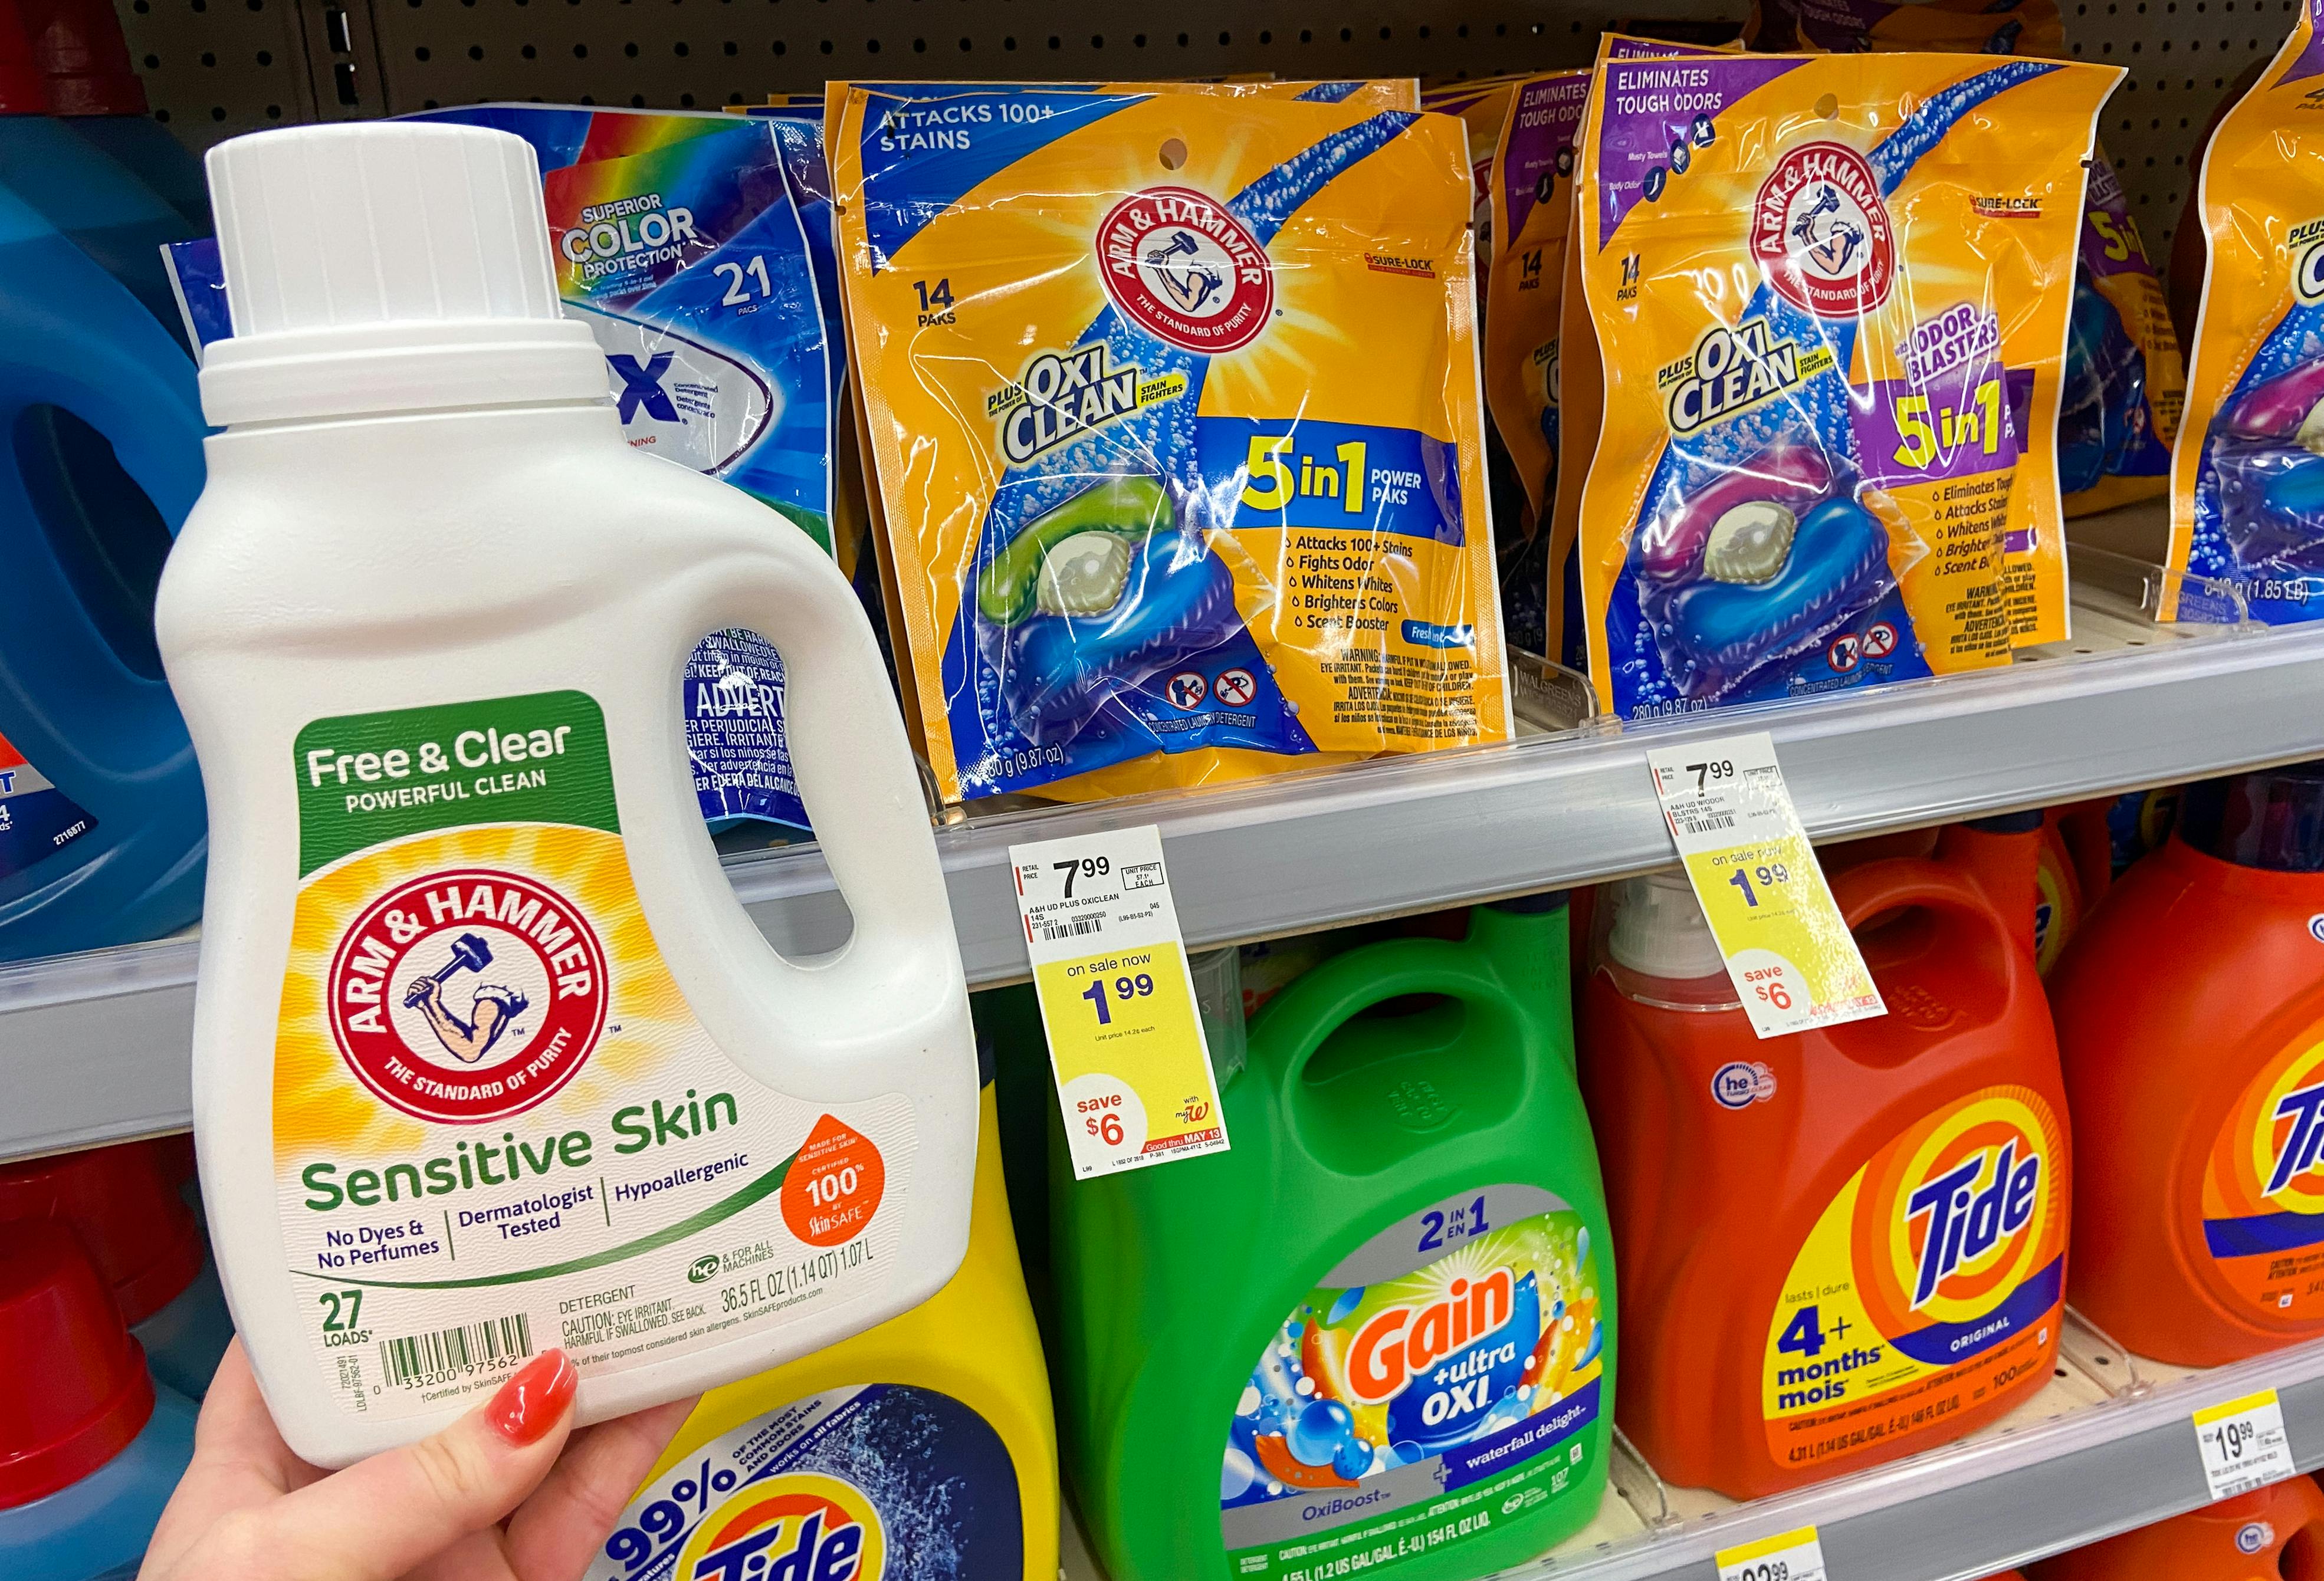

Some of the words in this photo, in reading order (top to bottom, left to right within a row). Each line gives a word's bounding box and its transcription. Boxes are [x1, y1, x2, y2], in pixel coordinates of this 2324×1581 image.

[1618, 70, 1709, 90] ELIMINATES
[881, 105, 992, 129] ATTACKS
[999, 104, 1053, 124] 100+
[1616, 97, 1669, 114] TOUGH
[1674, 93, 1722, 110] ODORS
[881, 132, 970, 152] STAINS
[583, 195, 662, 223] SUPERIOR
[1759, 189, 1788, 253] ARM
[1784, 164, 1800, 187] &
[1800, 152, 1887, 242] HAMMER
[562, 207, 697, 264] COLOR
[1112, 223, 1137, 279] ARM
[1129, 208, 1151, 231] &
[1154, 199, 1263, 285] HAMMER
[583, 246, 682, 280] PROTECTION
[1373, 256, 1432, 271] SURE-LOCK
[713, 255, 772, 307] 21
[914, 278, 955, 312] 14
[918, 312, 956, 328] PAKS
[1137, 294, 1155, 317] THE
[1155, 311, 1211, 337] STANDARD
[1212, 324, 1225, 337] OF
[1225, 304, 1252, 332] PURITY
[1917, 308, 1975, 353] ODOR
[1695, 318, 1771, 381] OXI
[1910, 318, 1997, 383] BLASTERS
[1025, 347, 1103, 406] OXI
[1140, 383, 1183, 400] FIGHTERS
[1141, 379, 1166, 396] STAIN
[1670, 343, 1798, 433] CLEAN
[987, 382, 1022, 410] PLUS
[1004, 368, 1137, 462] CLEAN
[1371, 469, 1421, 489] POWER
[1944, 482, 1995, 501] Eliminates
[1296, 537, 1346, 551] Attacks
[1351, 539, 1380, 553] 100+
[1382, 540, 1413, 557] Stains
[1299, 556, 1340, 572] Fights
[1342, 557, 1374, 570] Odor
[1302, 575, 1354, 590] Whitens
[1358, 578, 1393, 593] Whites
[1304, 595, 1365, 612] Brightens
[1369, 599, 1399, 613] Colors
[1307, 616, 1342, 629] Scent
[1345, 616, 1389, 630] Booster
[1214, 714, 1256, 728] DETERGENT
[1633, 704, 1651, 719] 280
[701, 721, 776, 734] PERJUDICIAL
[307, 748, 411, 786] Free
[418, 742, 449, 774] &
[455, 725, 571, 768] Clear
[720, 760, 775, 772] advertencia
[721, 747, 736, 758] los
[738, 747, 764, 758] niños
[346, 781, 470, 813] POWERFUL
[475, 770, 546, 796] CLEAN
[54, 820, 86, 845] 2716877
[1029, 905, 1045, 913] A&H
[1060, 899, 1079, 909] PLUS
[1082, 893, 1120, 905] OXICLEAN
[346, 934, 396, 1033] ARM
[386, 909, 428, 944] &
[424, 885, 592, 1001] HAMMER
[1067, 964, 1084, 977] on
[1089, 958, 1118, 973] sale
[1122, 953, 1151, 967] now
[1745, 967, 1783, 982] save
[1755, 982, 1791, 1010] $6
[1108, 1031, 1122, 1040] price
[383, 1057, 411, 1085] THE
[413, 1077, 504, 1102] STANDARD
[505, 1069, 528, 1090] OF
[527, 1027, 572, 1078] PURITY
[1727, 1076, 1747, 1090] he
[1077, 1094, 1121, 1112] save
[1086, 1114, 1124, 1146] $6
[1147, 1140, 1167, 1152] Good
[1168, 1139, 1183, 1148] thru
[1184, 1132, 1206, 1145] MAY
[1209, 1129, 1220, 1139] 13
[302, 1130, 593, 1211] Sensitive
[612, 1089, 737, 1154] Skin
[797, 1145, 838, 1163] SENSITIVE
[615, 1152, 749, 1202] Hypoallergenic
[812, 1156, 849, 1175] CERTIFIED
[805, 1163, 864, 1208] 100%
[458, 1184, 594, 1227] Dermatologist
[326, 1230, 353, 1247] No
[359, 1225, 405, 1247] Dyes
[409, 1220, 424, 1235] &
[498, 1214, 561, 1240] Tested
[1417, 1210, 1444, 1253] 2
[1450, 1208, 1465, 1223] IN
[1468, 1195, 1489, 1238] 1
[1447, 1222, 1465, 1239] EN
[1905, 1136, 2041, 1312] Tide
[318, 1253, 344, 1268] No
[351, 1238, 439, 1265] Perfumes
[723, 1253, 730, 1263] &
[732, 1247, 751, 1261] FOR
[754, 1240, 772, 1255] ALL
[723, 1249, 774, 1273] MACHINES
[721, 1285, 749, 1313] 36.5
[750, 1278, 767, 1301] FL
[768, 1270, 784, 1297] OZ
[786, 1263, 816, 1295] (1.14
[817, 1250, 838, 1281] QT)
[840, 1243, 864, 1271] 1.07
[865, 1238, 873, 1260] L
[559, 1284, 636, 1314] DETERGENT
[1785, 1289, 1813, 1304] lasts
[1823, 1281, 1849, 1296] dure
[319, 1289, 362, 1332] 27
[562, 1314, 615, 1337] CAUTION:
[618, 1309, 633, 1324] EYE
[634, 1298, 675, 1321] IRRITANT.
[564, 1328, 605, 1350] HARMFUL
[606, 1328, 614, 1342] IF
[615, 1314, 670, 1339] SWALLOWED.
[672, 1309, 685, 1324] SEE
[686, 1304, 705, 1321] BACK.
[1348, 1271, 1509, 1399] Gain
[1950, 1317, 2010, 1352] ORIGINAL
[592, 1352, 609, 1365] their
[612, 1343, 645, 1362] topmost
[646, 1332, 687, 1351] considered
[690, 1326, 704, 1337] skin
[403, 1369, 456, 1391] 33200
[465, 1355, 518, 1376] 97562
[1422, 1375, 1491, 1426] OXI
[731, 1448, 747, 1460] OF
[746, 1432, 769, 1451] THE
[767, 1406, 799, 1433] MOST
[739, 1431, 784, 1466] COMMON
[784, 1399, 822, 1433] STAINS
[770, 1448, 801, 1474] works
[799, 1436, 813, 1449] on
[813, 1422, 827, 1438] all
[826, 1400, 861, 1429] fabrics
[1466, 1431, 1534, 1470] waterfall
[1535, 1406, 1582, 1439] delight
[746, 1452, 768, 1474] AND
[767, 1424, 806, 1456] ODORS
[606, 1457, 737, 1572] 99%
[1302, 1490, 1381, 1521] OxiBoost
[695, 1507, 866, 1581] Tide
[1427, 1528, 1445, 1546] 154
